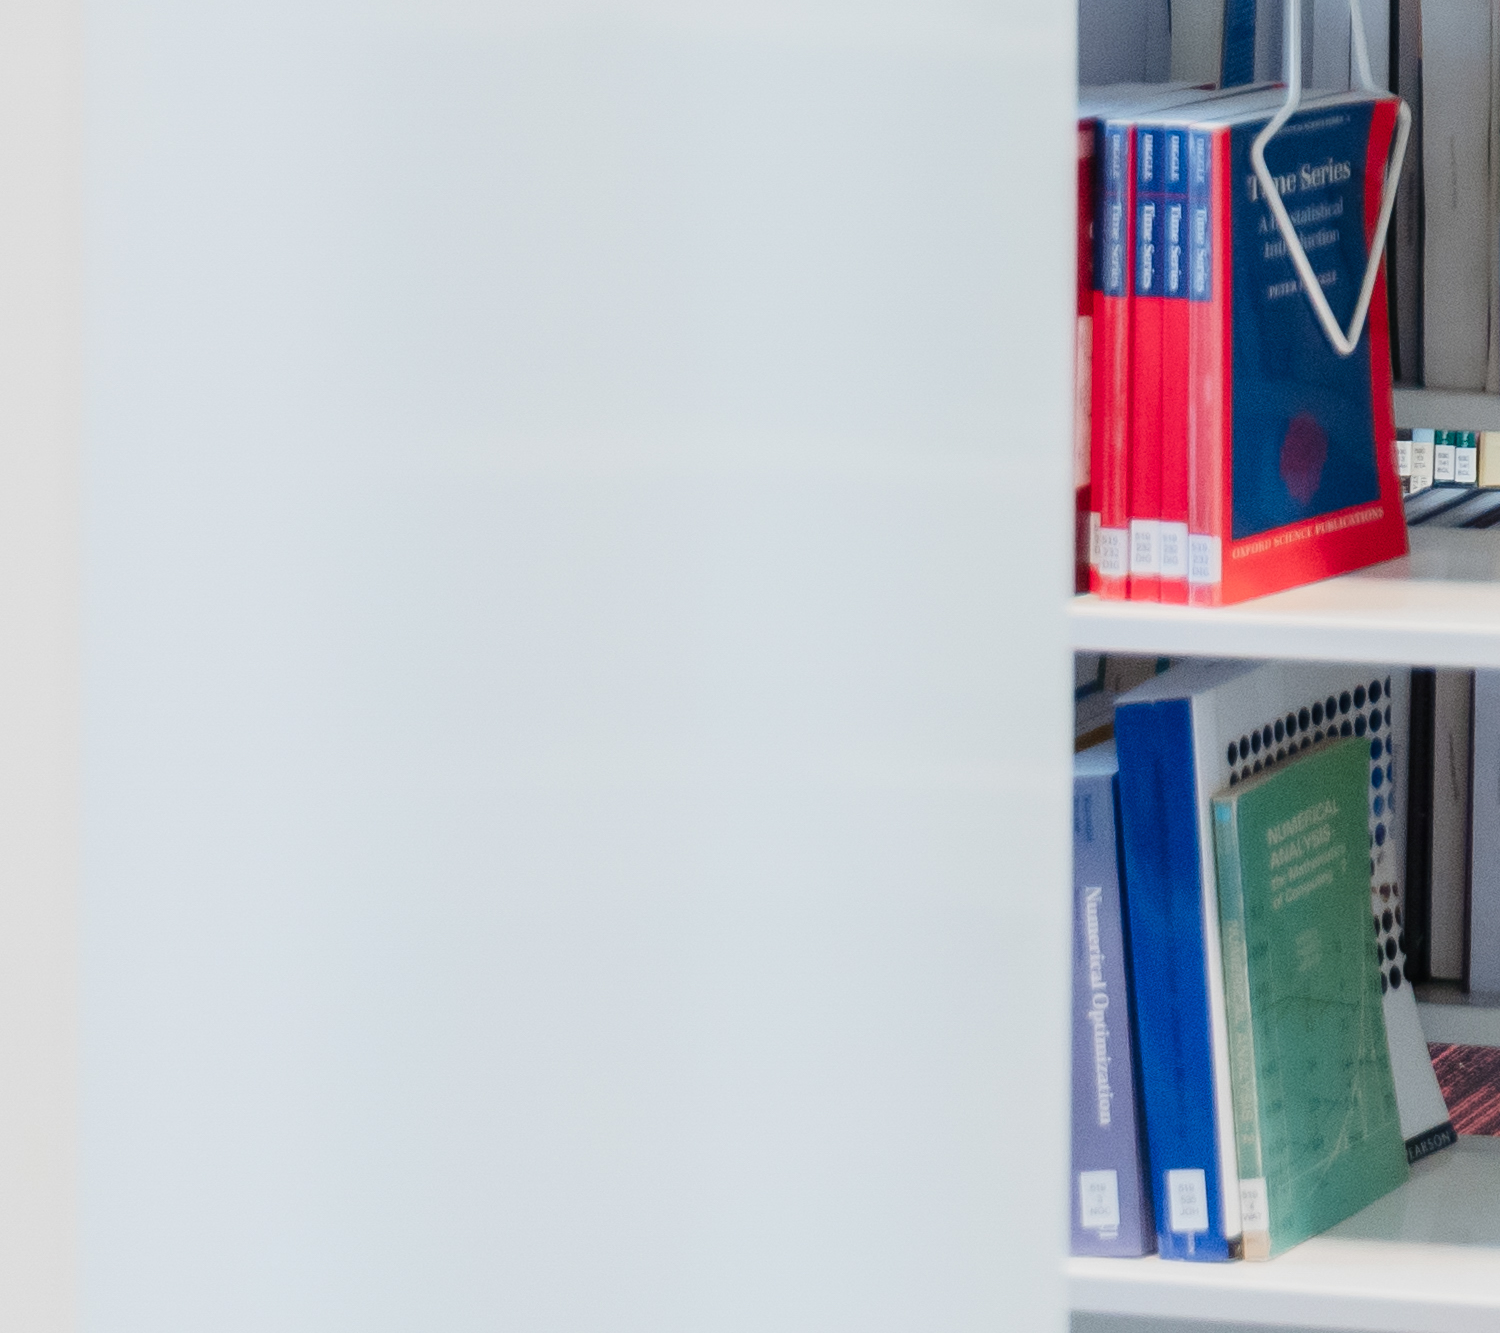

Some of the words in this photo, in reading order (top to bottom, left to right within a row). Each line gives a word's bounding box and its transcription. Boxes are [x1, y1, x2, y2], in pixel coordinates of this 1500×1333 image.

[1247, 172, 1297, 203] Tme
[1301, 157, 1351, 191] Series
[1112, 203, 1122, 241] Time
[1144, 202, 1156, 241] Time
[1170, 202, 1182, 244] Time
[1197, 206, 1207, 245] Time
[1264, 228, 1341, 260] Intruction
[1111, 243, 1122, 288] Series
[1141, 243, 1155, 290] Series
[1170, 244, 1182, 292] Series
[1196, 247, 1207, 294] Series
[1232, 539, 1272, 560] OXFORD
[1273, 529, 1315, 549] SCIENCE
[1315, 507, 1385, 536] PUBLICATIONS
[1085, 886, 1108, 990] Numerical
[1088, 992, 1112, 1126] Optimization
[1408, 1131, 1451, 1161] EARSON
